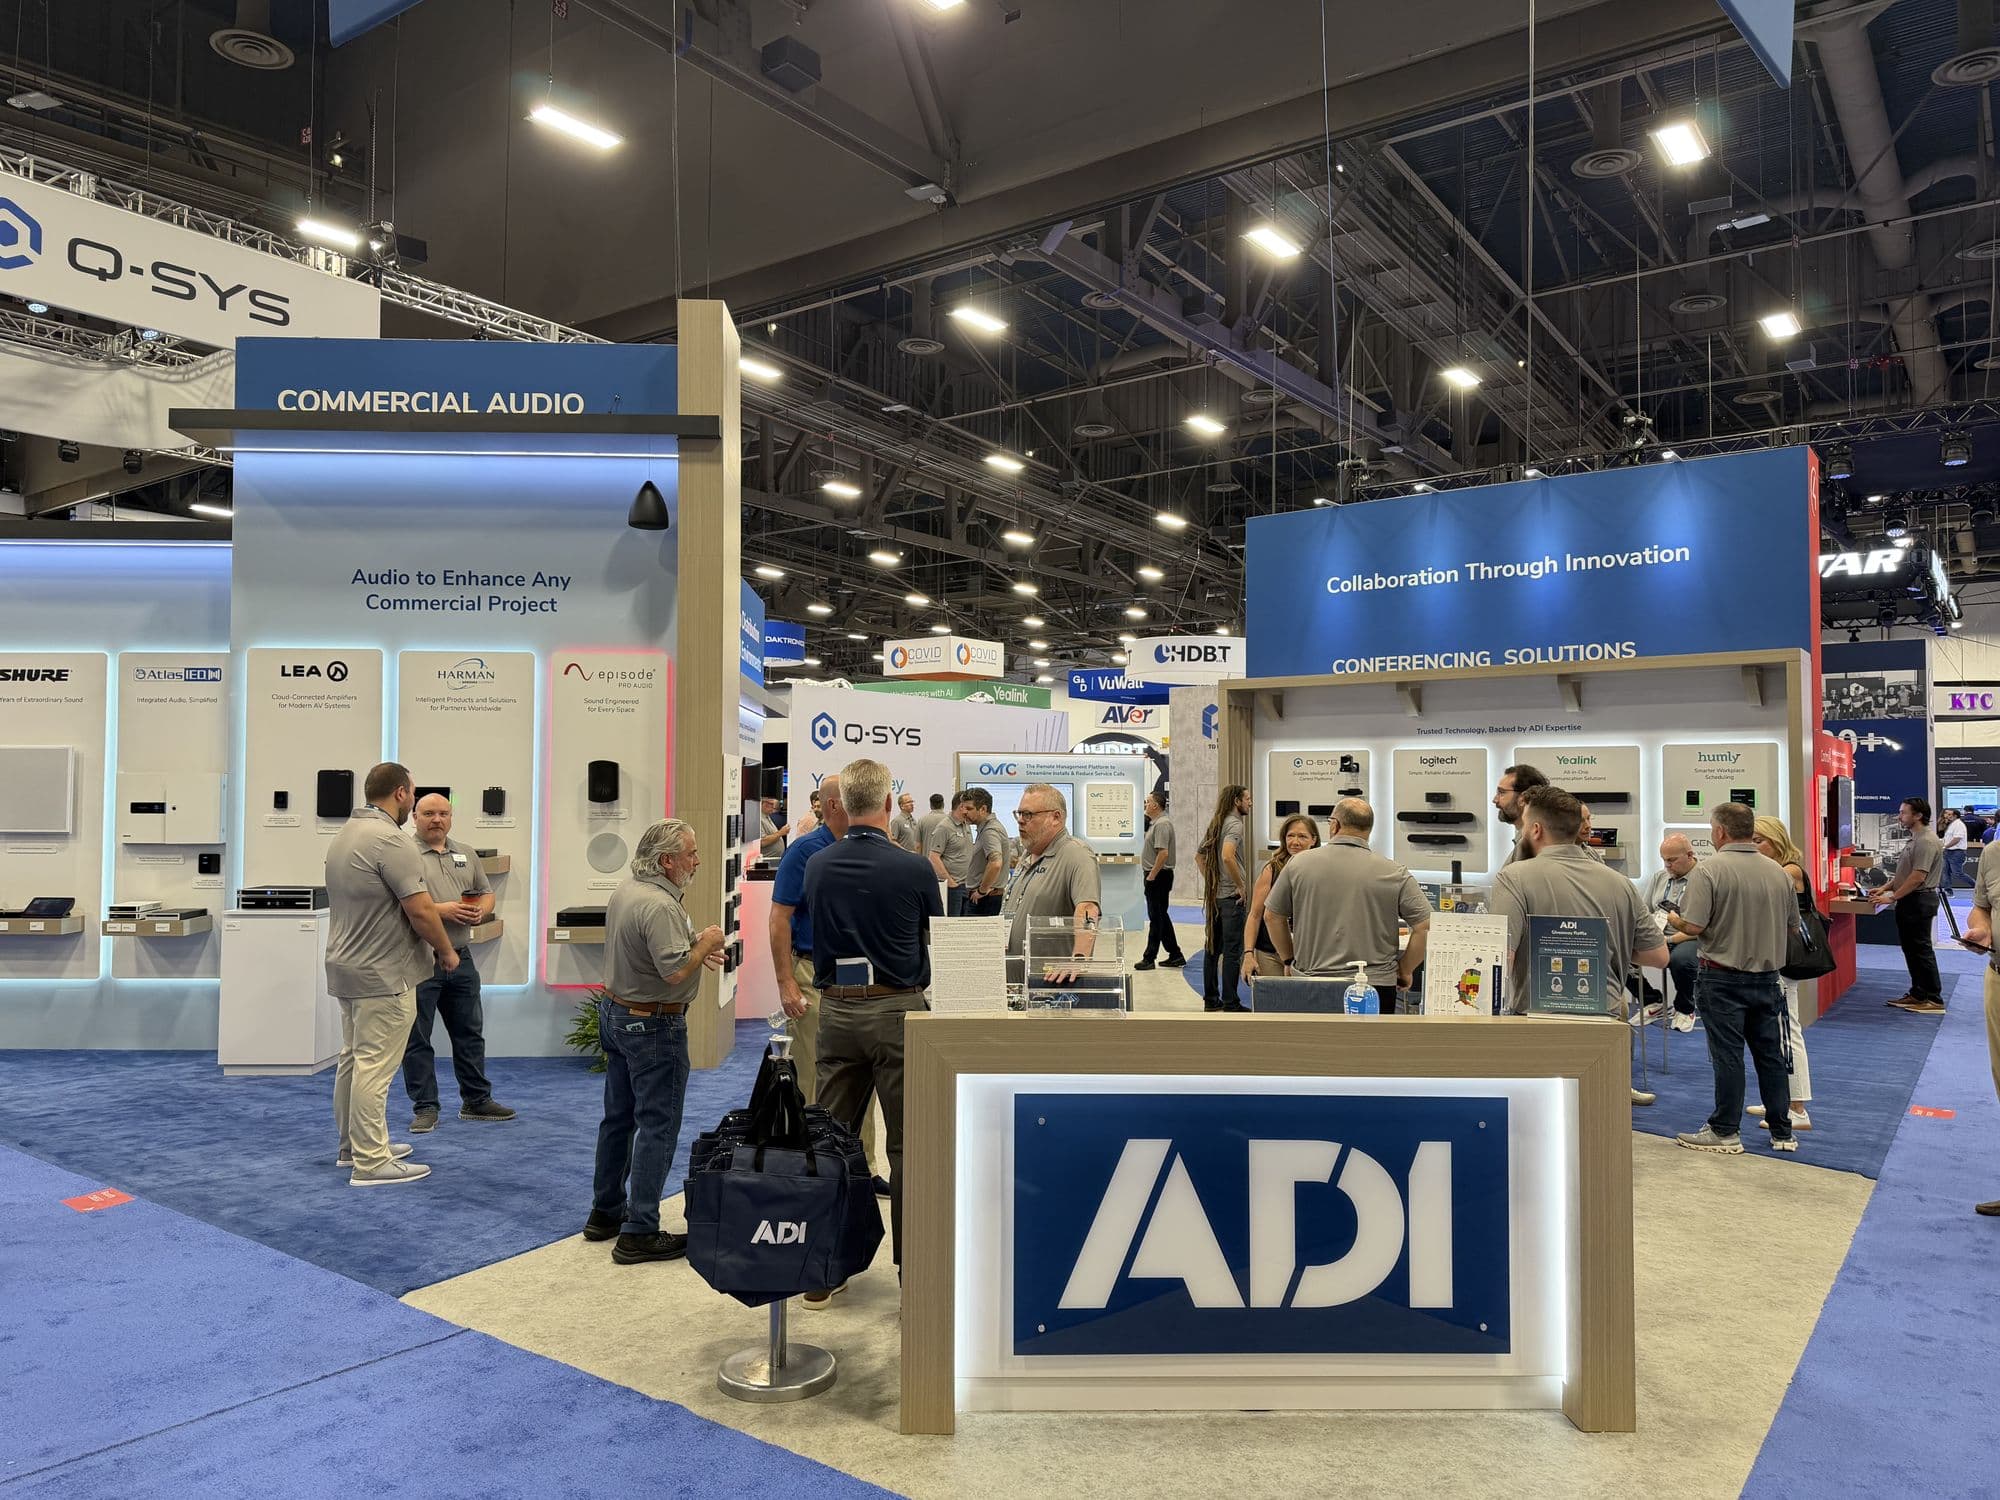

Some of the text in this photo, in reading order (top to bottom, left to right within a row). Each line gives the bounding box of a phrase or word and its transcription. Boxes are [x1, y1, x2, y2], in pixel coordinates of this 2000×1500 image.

[67, 236, 291, 327] Q-SYS
[277, 389, 586, 416] COMMERCIAL AUDIO
[1326, 545, 1691, 594] Collaboration Through Innovation
[351, 567, 572, 592] Audio to Enhance Any
[365, 593, 558, 617] Commercial Project
[908, 647, 942, 660] COVID
[970, 647, 998, 661] COVID
[1171, 645, 1231, 663] HDBT
[1332, 641, 1637, 676] CONFERENCING SOLUTIONS
[0, 668, 70, 682] SHURE
[280, 665, 322, 678] LEA
[437, 670, 495, 679] HARMAN
[598, 668, 653, 683] episode
[136, 697, 168, 705] Integrated
[326, 694, 358, 702] Amplifiers
[992, 685, 1028, 704] Yealink
[1948, 692, 1994, 711] KTC
[605, 698, 640, 706] Engineered
[844, 723, 922, 746] Q-SYS
[1416, 727, 1443, 735] Trusted
[1444, 727, 1488, 736] Technology,
[1517, 726, 1527, 734] by
[1545, 724, 1582, 733] Expertise
[1419, 755, 1458, 768] logitech
[1556, 755, 1598, 765] Yealink
[1697, 751, 1742, 764] humly
[1559, 921, 1578, 929] ADI
[1056, 1137, 1455, 1310] ADI
[750, 1219, 807, 1245] ADI
